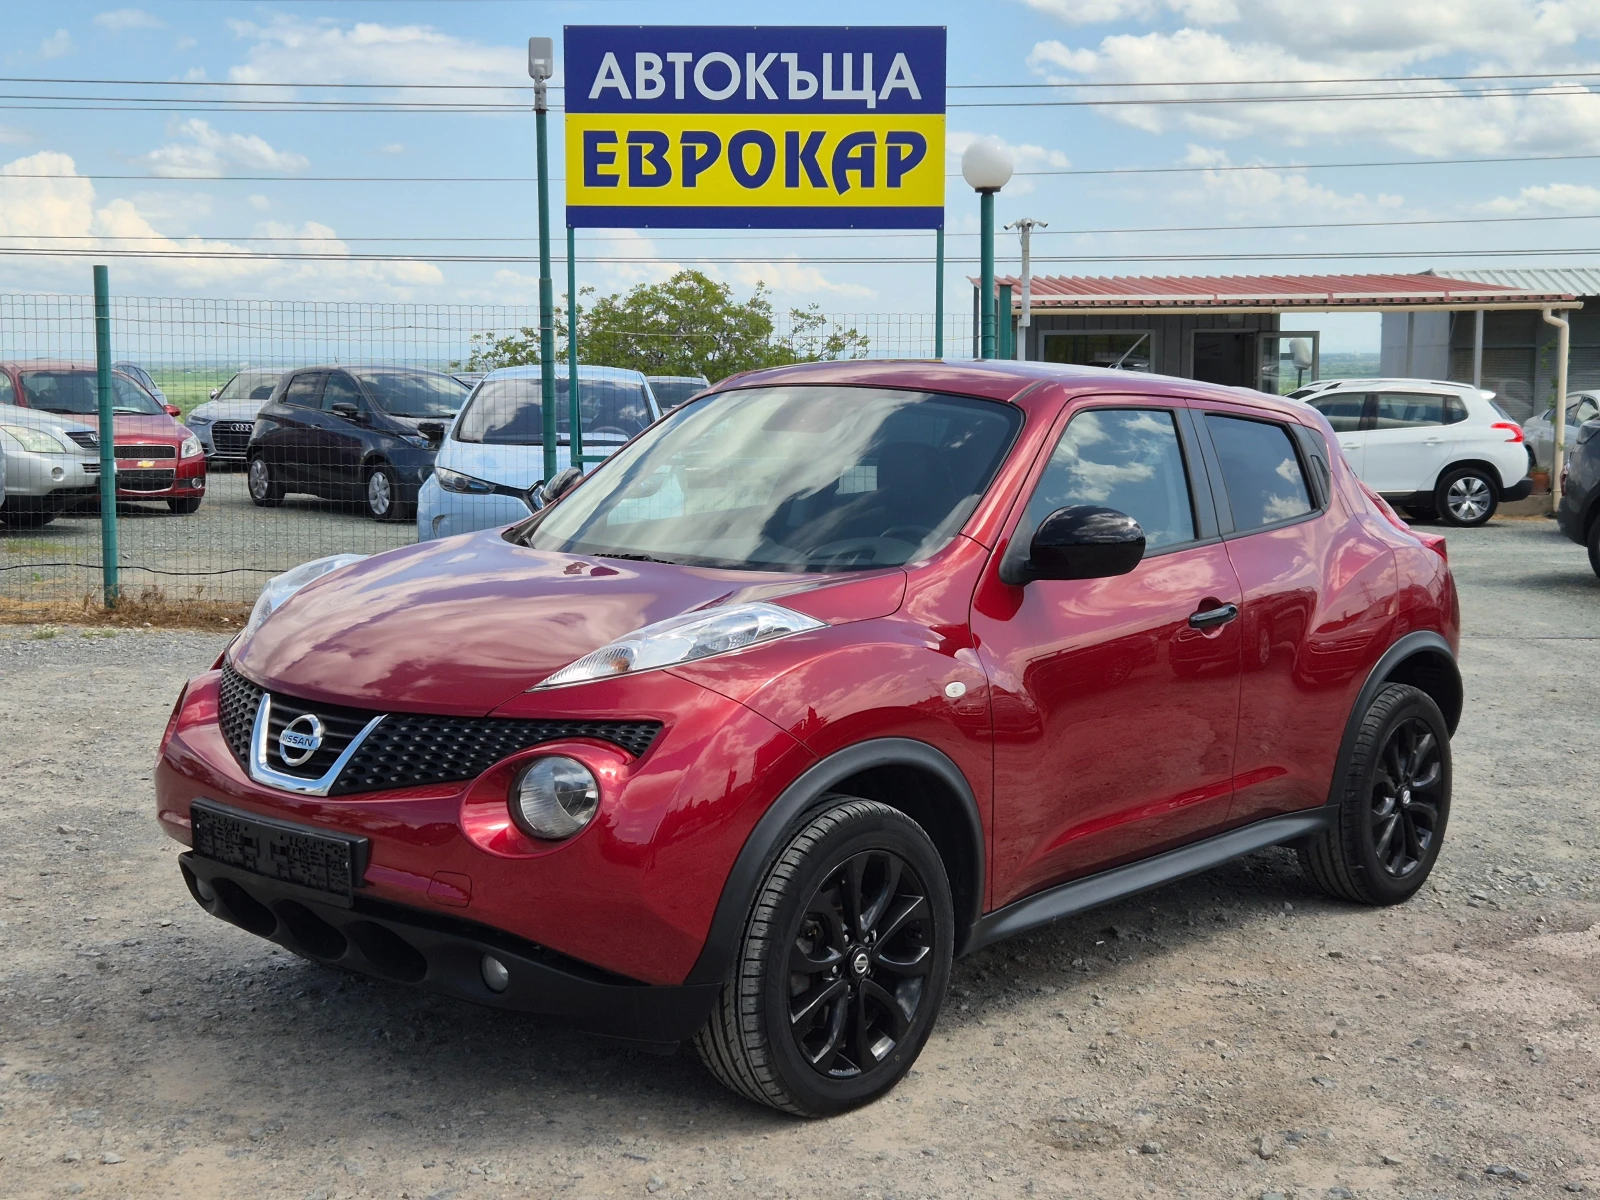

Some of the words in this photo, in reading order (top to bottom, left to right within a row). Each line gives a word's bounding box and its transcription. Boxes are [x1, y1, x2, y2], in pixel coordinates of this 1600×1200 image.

[588, 51, 922, 109] АВТОКЪЩА
[583, 129, 927, 196] ЕВРОКАР
[282, 733, 314, 747] NISSAN
